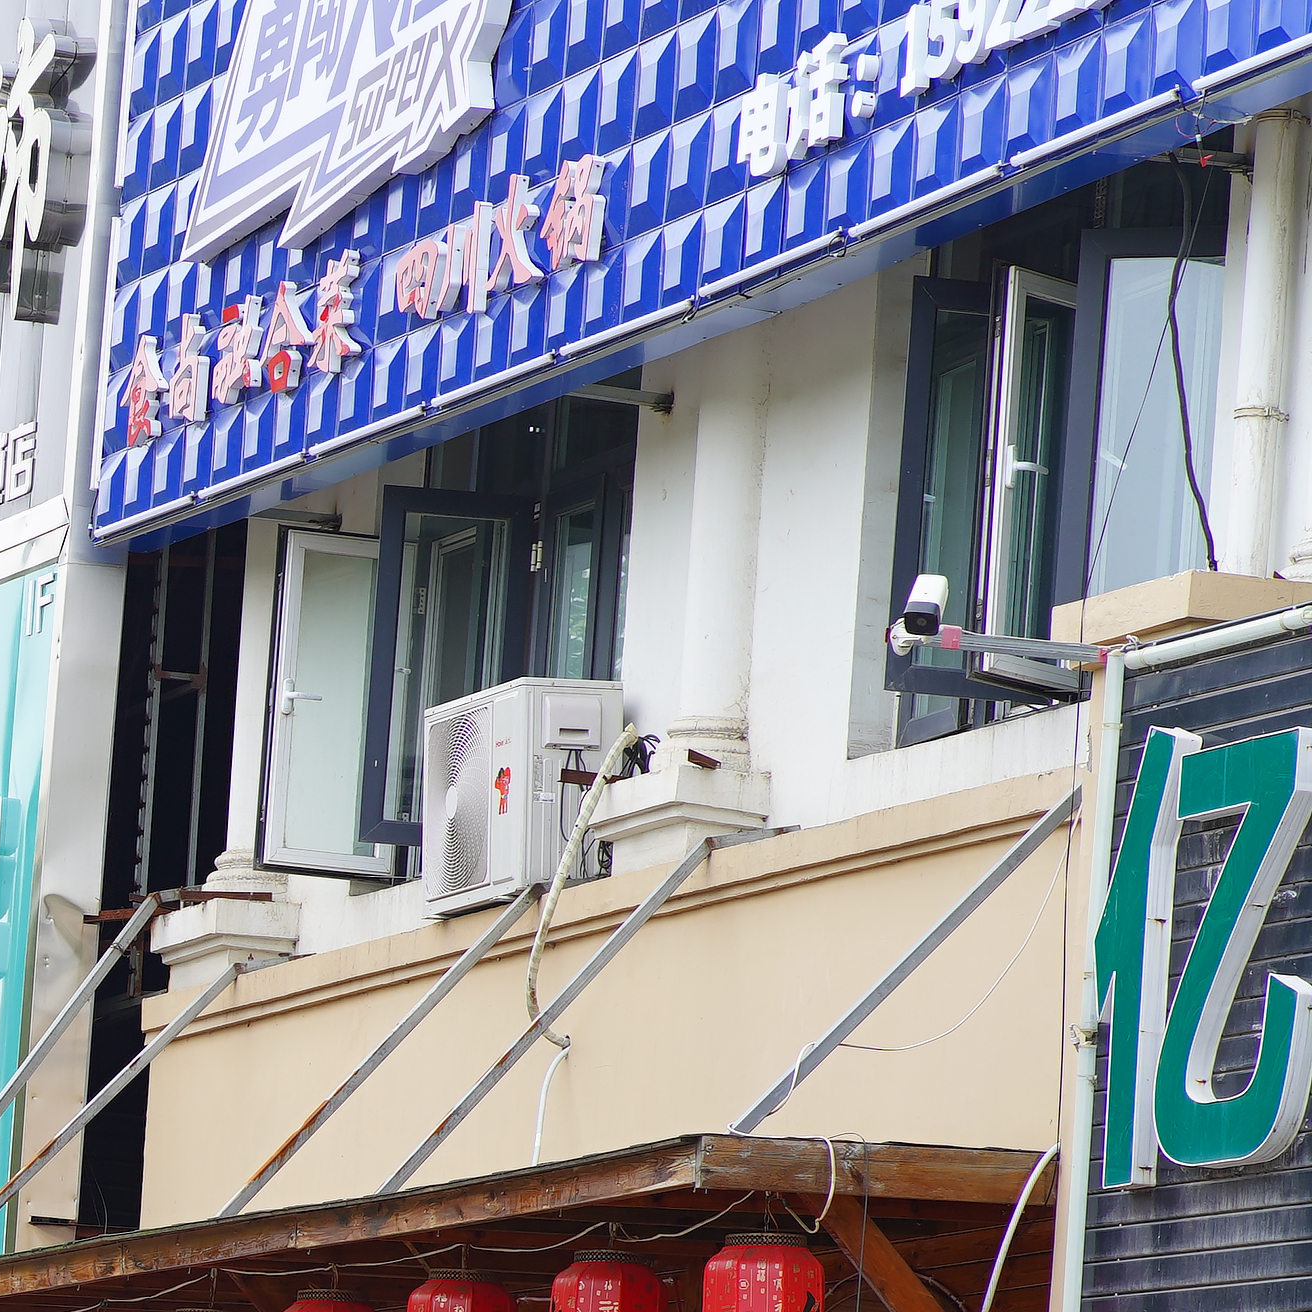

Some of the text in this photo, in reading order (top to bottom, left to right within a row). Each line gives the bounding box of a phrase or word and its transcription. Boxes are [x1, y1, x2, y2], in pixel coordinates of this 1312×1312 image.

[119, 153, 607, 447] 食尚融合菜 四川火锅
